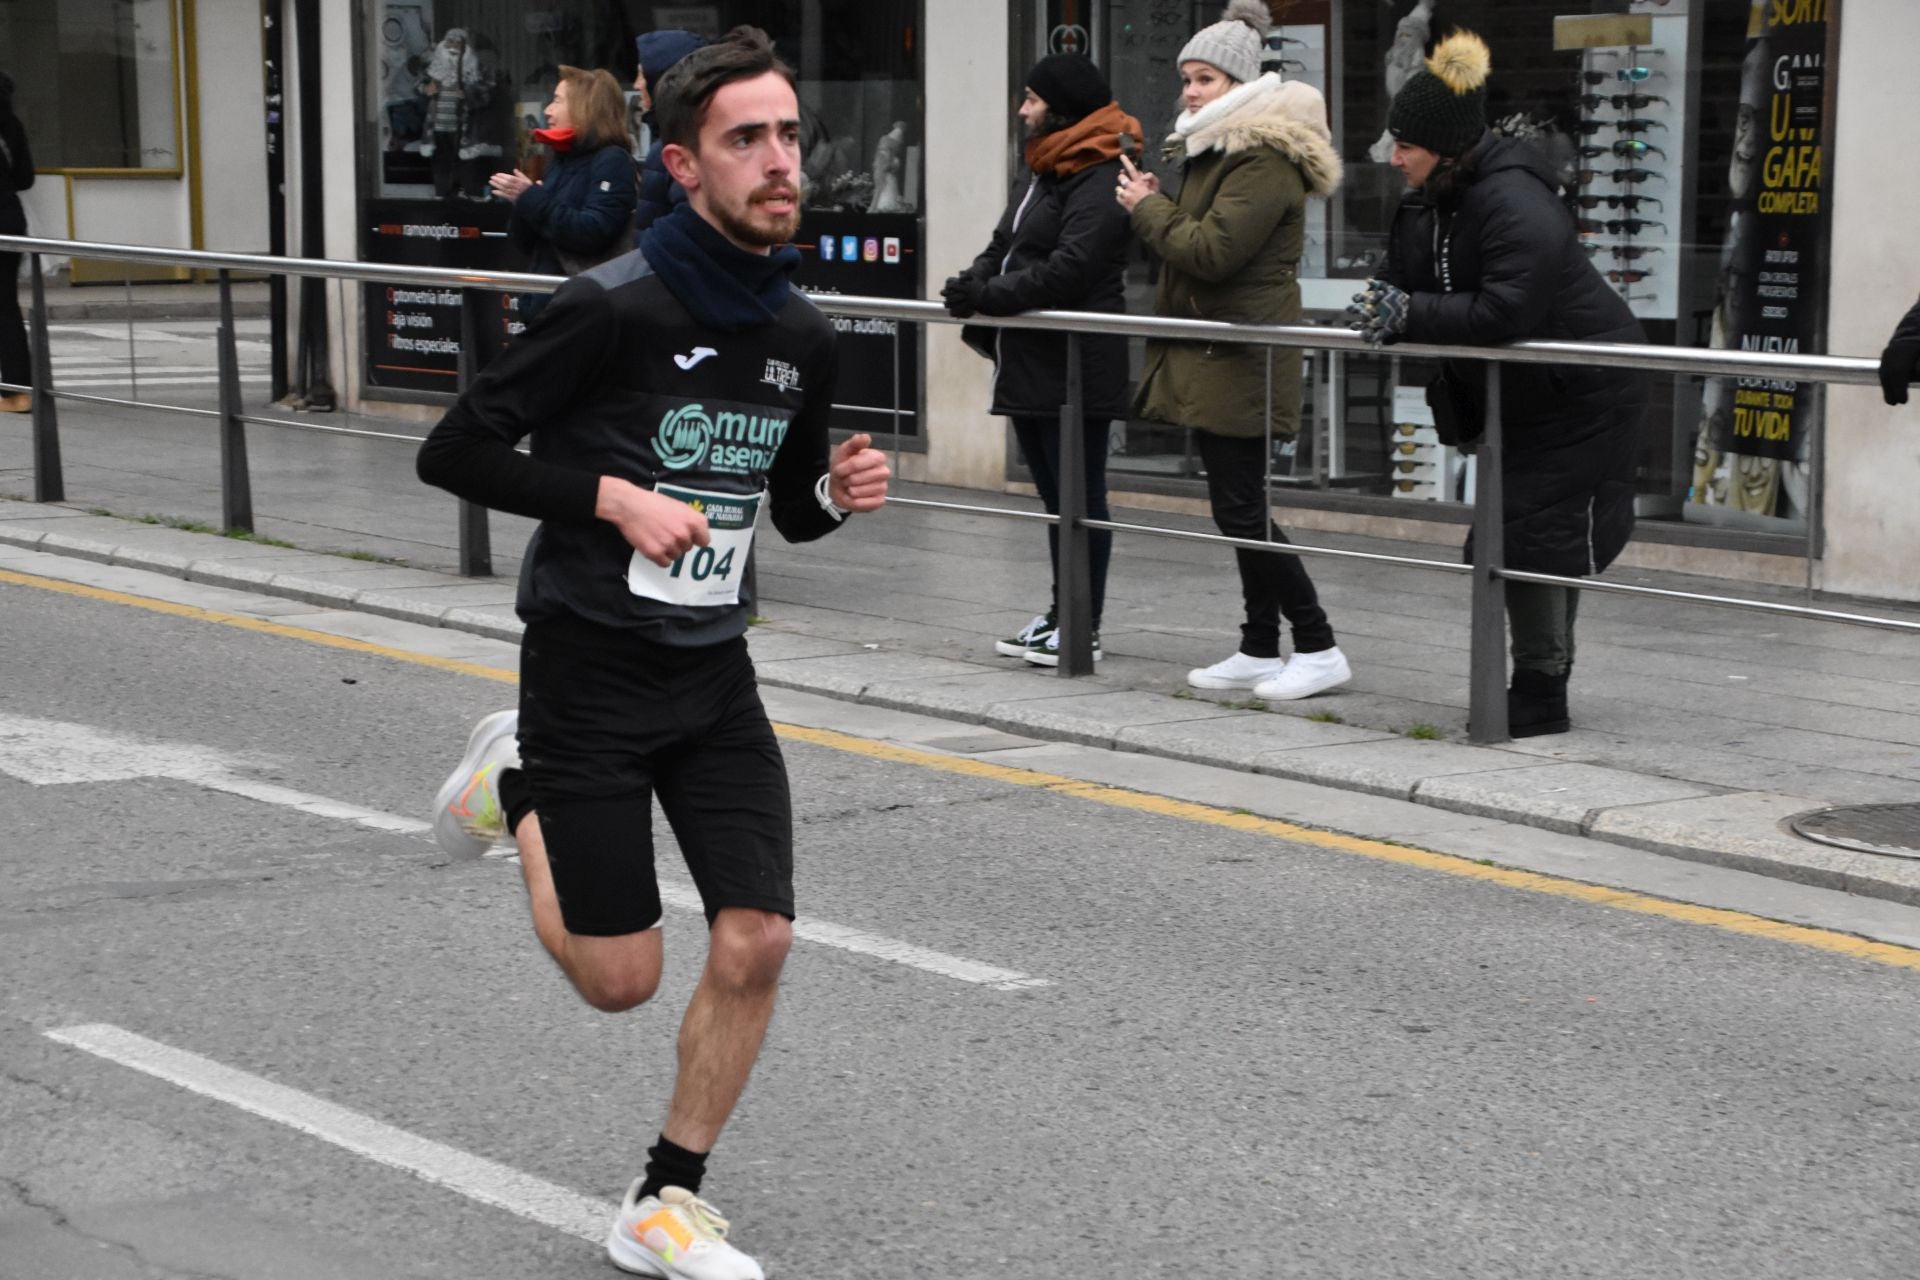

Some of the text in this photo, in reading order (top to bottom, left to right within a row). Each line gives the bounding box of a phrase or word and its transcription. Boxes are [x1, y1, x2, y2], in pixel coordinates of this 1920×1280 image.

[1763, 145, 1822, 188] GAFA
[1758, 191, 1818, 214] COMPLETA
[386, 310, 434, 329] Baja visión
[386, 332, 460, 355] Filtros especiales
[1732, 408, 1791, 441] TU VIDA
